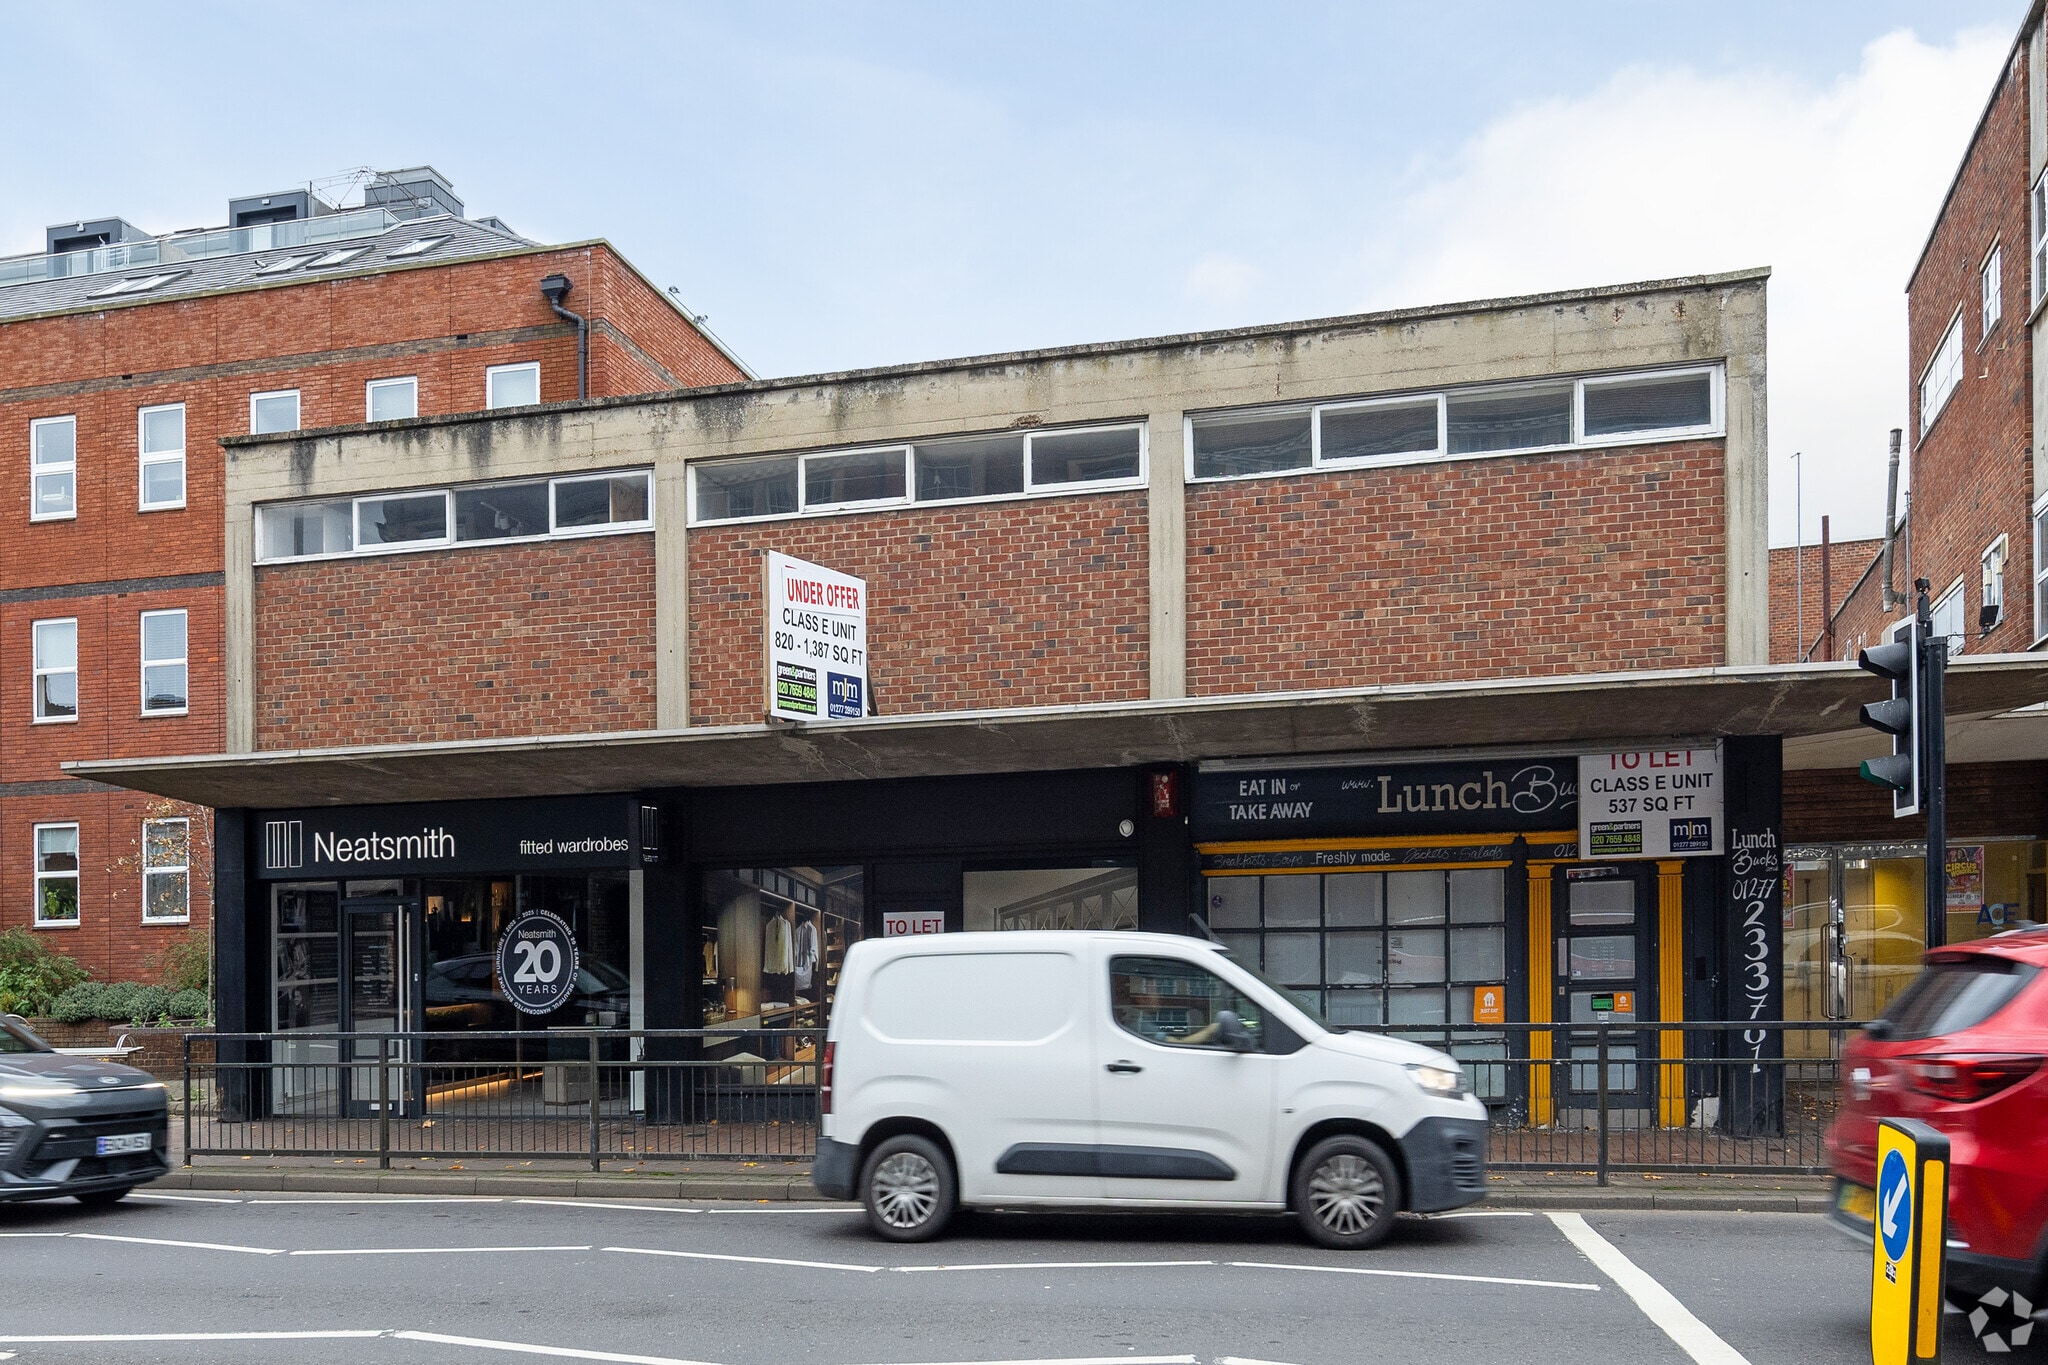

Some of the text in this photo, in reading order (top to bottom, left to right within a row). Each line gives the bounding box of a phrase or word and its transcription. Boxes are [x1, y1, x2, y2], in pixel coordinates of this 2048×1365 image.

[787, 578, 860, 610] UNDER OFFER
[783, 608, 856, 641] CLASS E UNIT
[775, 631, 794, 651] 820
[804, 638, 829, 659] 1,387
[833, 646, 849, 665] SQ
[852, 648, 863, 666] FT
[778, 681, 789, 695] 020
[1610, 750, 1692, 770] TO LET
[1239, 778, 1301, 796] EAT IN or
[1590, 772, 1713, 793] CLASS E UNIT
[1377, 771, 1511, 813] Lunch
[1229, 802, 1313, 820] TAKE AWAY
[1609, 795, 1695, 813] 537 SQ FT
[1591, 822, 1641, 833] green&partners
[315, 827, 455, 862] Neatsmith
[520, 836, 629, 854] fitted wardrobes
[1592, 833, 1641, 845] 020 7659 4848
[1732, 827, 1776, 849] Lunch
[1402, 846, 1504, 864] Jackets Salads
[1554, 844, 1577, 858] 012
[1732, 848, 1778, 875] Bucks
[1945, 862, 1977, 873] CIRCUS
[1733, 877, 1777, 900] 01277
[540, 909, 572, 935] CELEBRATING
[886, 919, 942, 934] TO LET
[518, 929, 557, 939] Neatsmith
[514, 940, 561, 983] 20
[518, 984, 557, 994] YEARS
